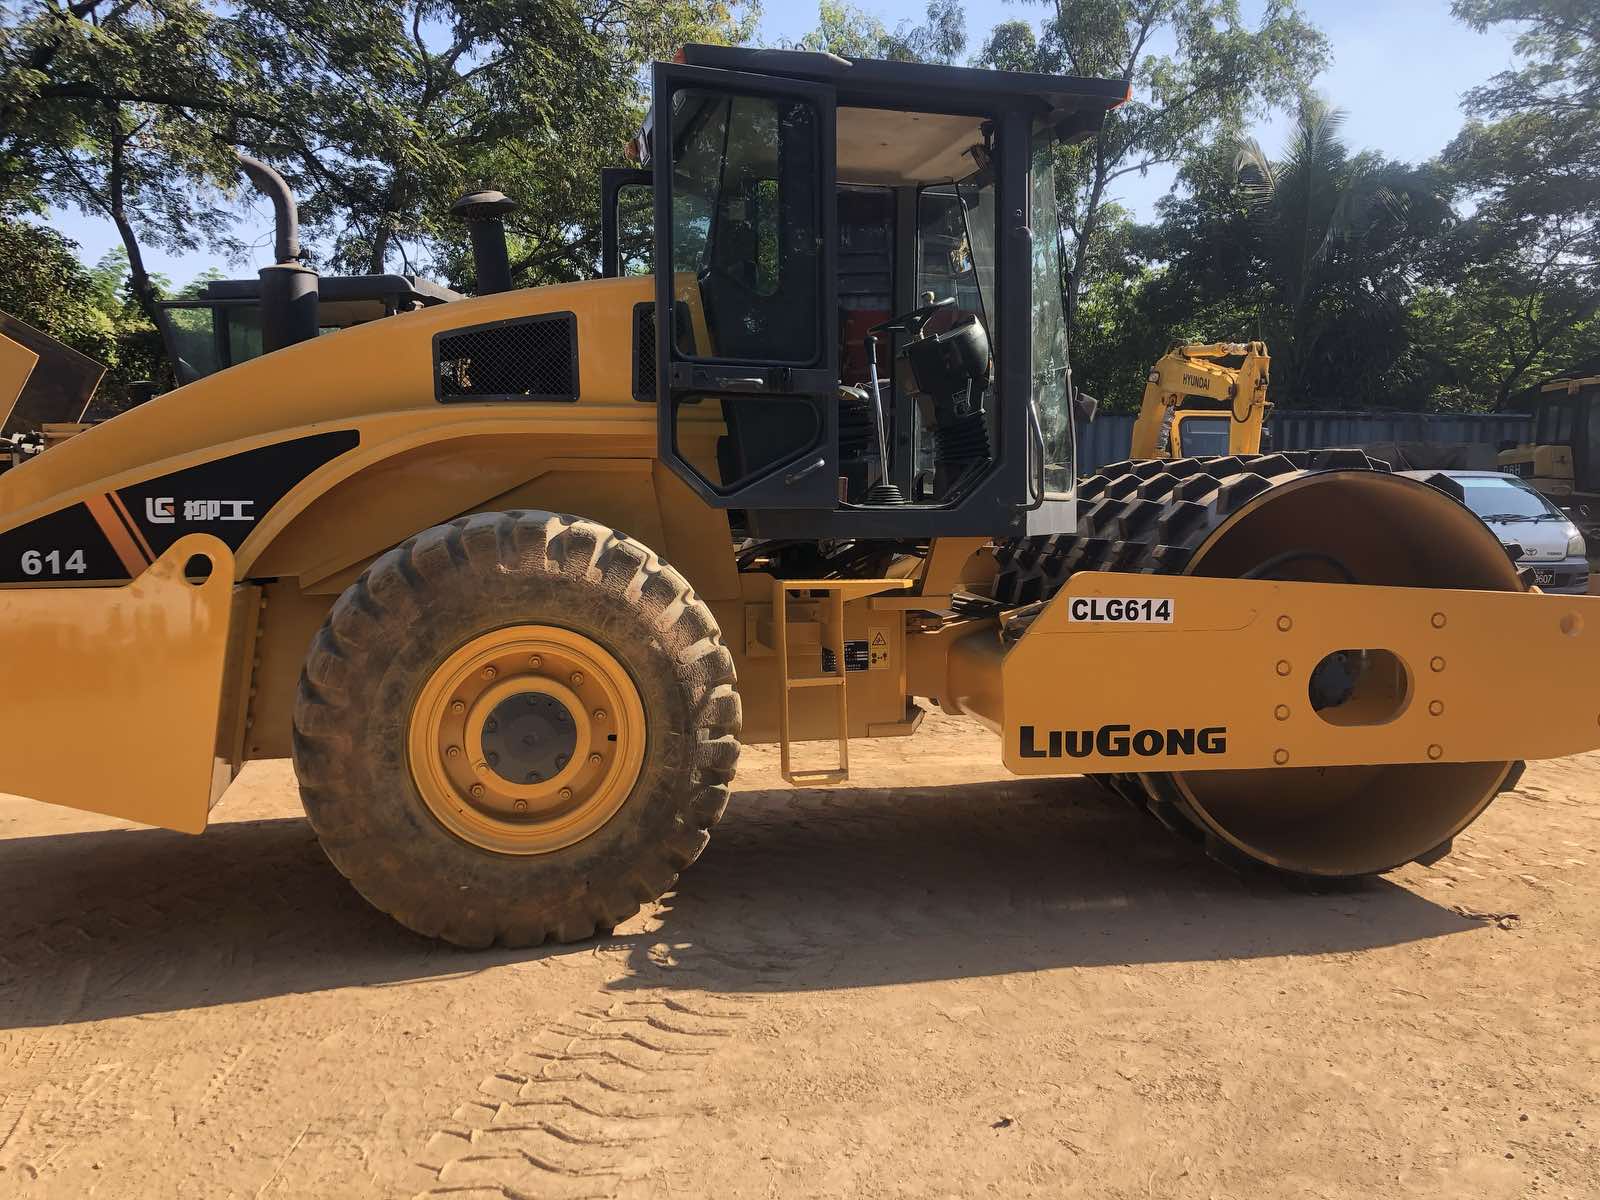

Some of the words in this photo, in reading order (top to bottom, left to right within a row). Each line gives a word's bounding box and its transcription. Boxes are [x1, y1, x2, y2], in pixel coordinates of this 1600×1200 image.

[1183, 373, 1210, 390] HYUNDAI
[183, 500, 255, 521] 柳工
[20, 549, 87, 576] 614
[1071, 599, 1171, 621] CLG614
